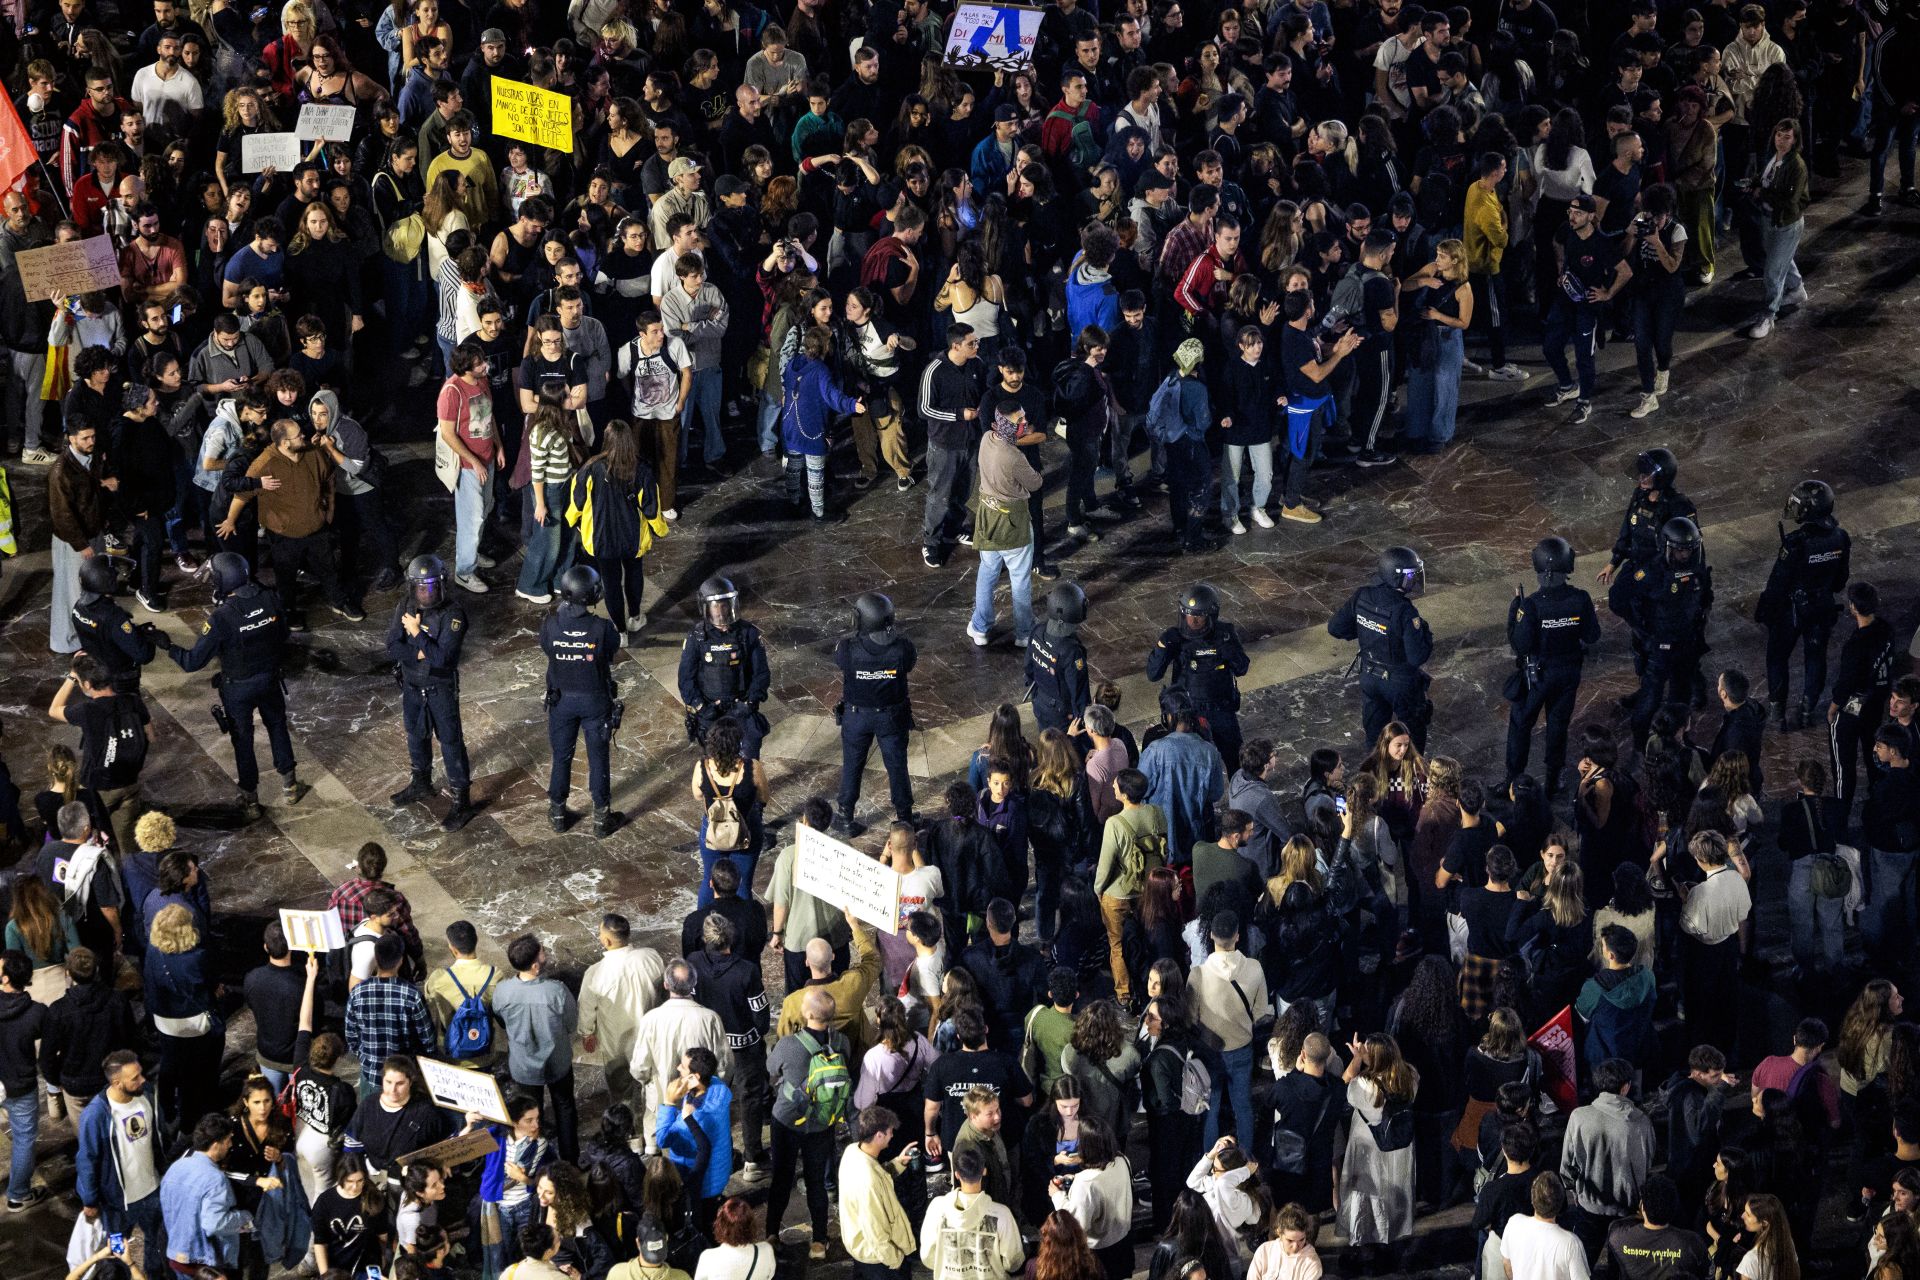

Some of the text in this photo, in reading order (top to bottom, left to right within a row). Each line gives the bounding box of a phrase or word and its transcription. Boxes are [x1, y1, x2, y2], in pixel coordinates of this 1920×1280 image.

[954, 28, 1036, 44] DI MI SIÓN
[496, 86, 559, 110] NUESTRAS VIDAS EN
[316, 107, 328, 117] DANA
[496, 100, 568, 124] MANOS DE LOS JEFES
[508, 113, 561, 133] NO SON VIDAS
[512, 123, 568, 149] SON MUERTES
[248, 156, 277, 169] SISTEMA
[240, 616, 272, 632] POLICIA
[1357, 614, 1380, 628] POLICIA
[1357, 618, 1386, 634] NACIONAL
[552, 640, 589, 649] POLICIA
[1032, 639, 1053, 661] POLICIA
[806, 834, 825, 848] para
[834, 849, 846, 859] que
[840, 864, 863, 879] basta
[804, 871, 818, 883] bien
[842, 888, 864, 904] hagan
[868, 904, 890, 918] nada
[1623, 1245, 1650, 1258] Sensory
